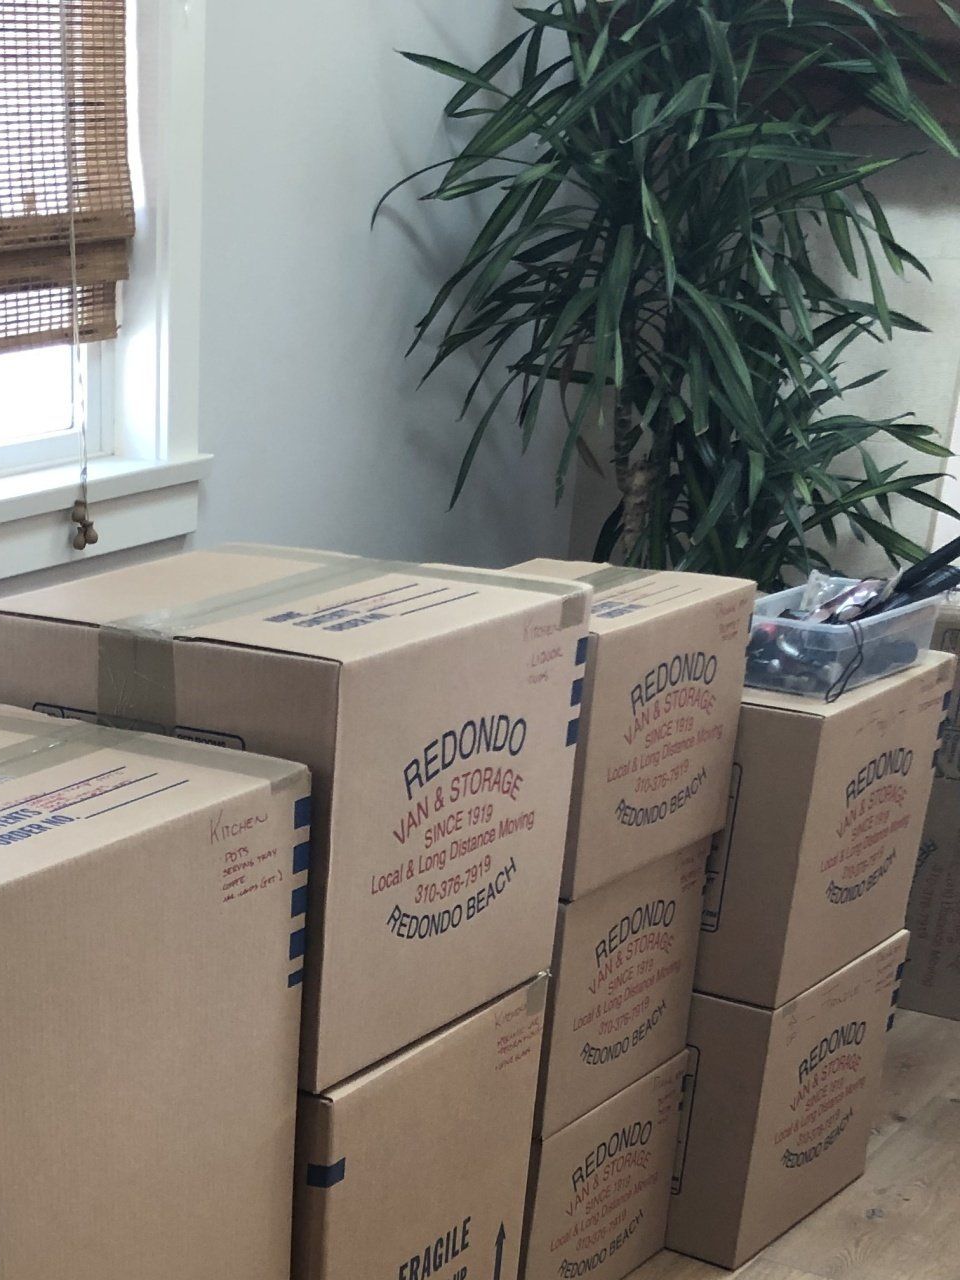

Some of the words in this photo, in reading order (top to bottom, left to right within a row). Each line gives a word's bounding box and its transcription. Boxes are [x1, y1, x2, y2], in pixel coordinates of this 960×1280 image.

[624, 708, 650, 745] VAN
[665, 687, 716, 715] STORAGE
[631, 652, 717, 717] REDONDO
[403, 714, 526, 801] REDONDO
[847, 747, 912, 808] REDONDO
[209, 809, 268, 845] KITCHEN
[393, 795, 428, 844] VAN
[434, 786, 444, 812] &
[449, 767, 523, 802] STORAGE
[424, 810, 463, 849] SINCE
[467, 804, 492, 825] 1919
[615, 798, 667, 826] REDONDO
[670, 766, 707, 814] BEACH
[371, 863, 402, 895] Local
[406, 860, 414, 879] &
[418, 850, 446, 874] Long
[449, 829, 495, 860] Distance
[498, 810, 534, 838] Moving
[386, 904, 462, 939] REDONDO
[466, 856, 516, 920] BEACH
[826, 880, 865, 904] REDONDO
[589, 957, 612, 994] VAN
[627, 931, 674, 961] STORAGE
[595, 899, 676, 968] REDONDO
[581, 1042, 630, 1065] REDONDO
[632, 999, 666, 1047] BEACH
[799, 1021, 865, 1084] REDONDO
[566, 1182, 590, 1217] VAN
[604, 1149, 651, 1181] STORAGE
[572, 1120, 652, 1193] REDONDO
[781, 1142, 821, 1168] REDONDO
[560, 1259, 607, 1279] REDONDO
[609, 1209, 644, 1256] BEACH
